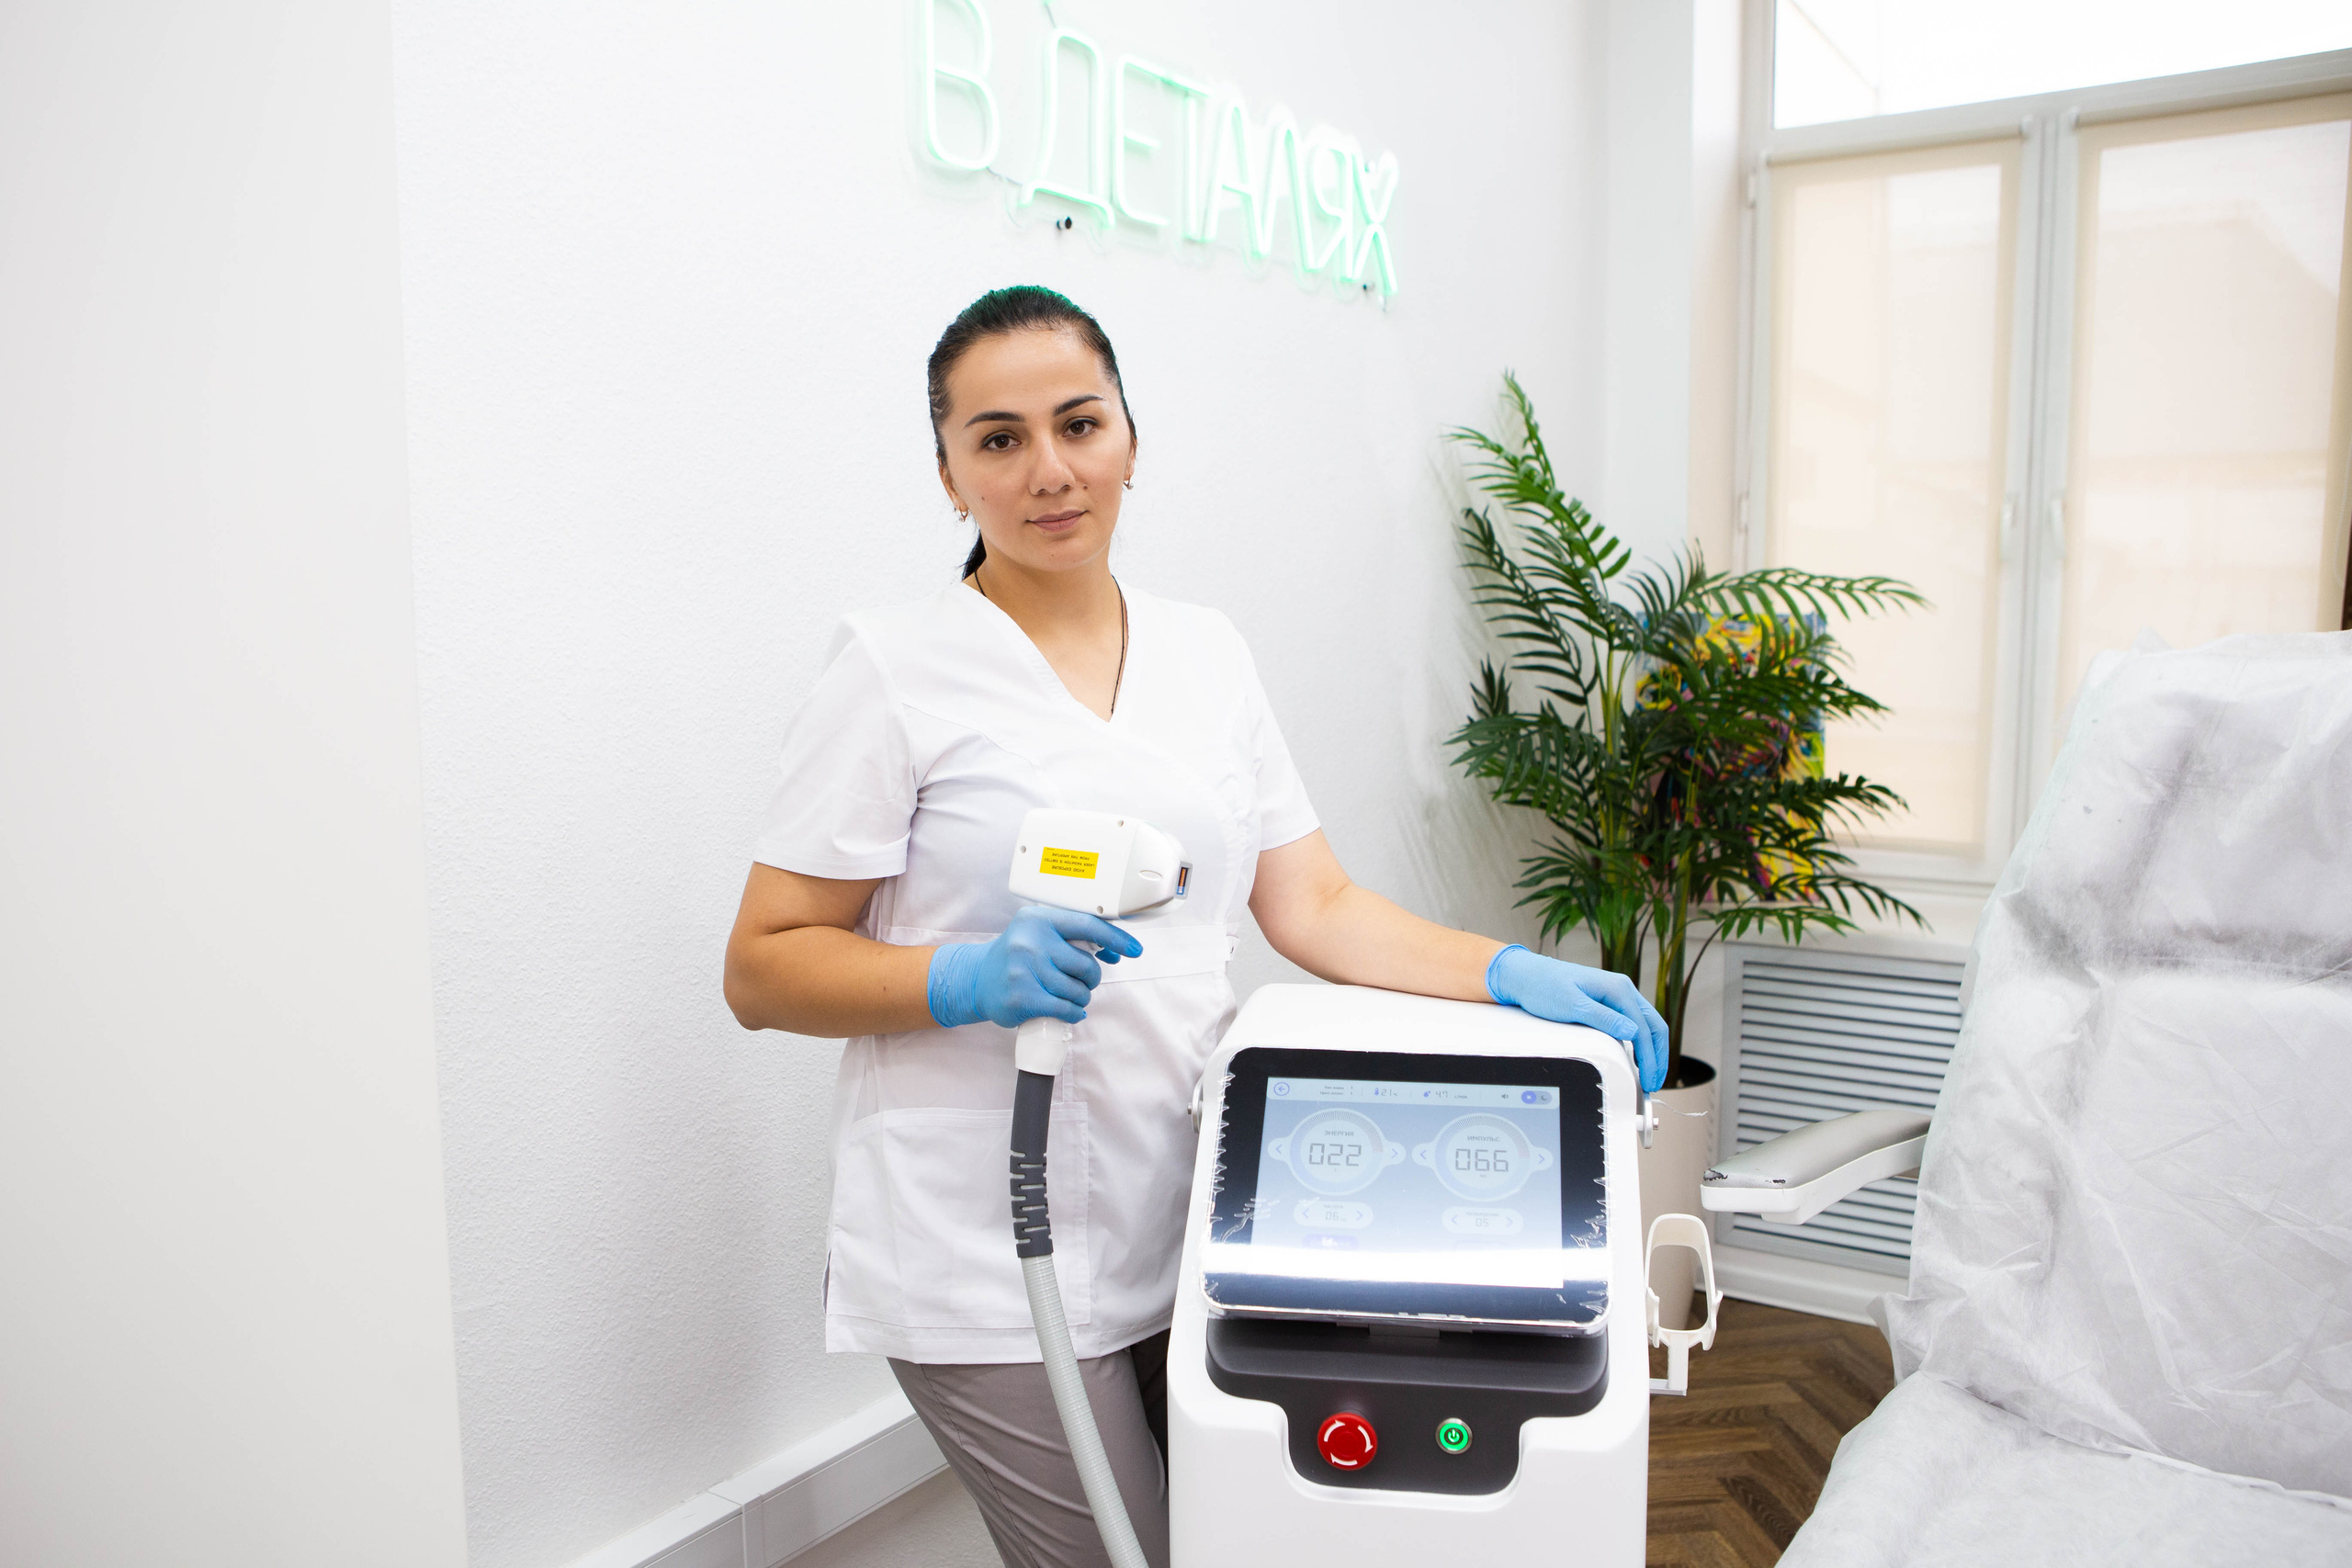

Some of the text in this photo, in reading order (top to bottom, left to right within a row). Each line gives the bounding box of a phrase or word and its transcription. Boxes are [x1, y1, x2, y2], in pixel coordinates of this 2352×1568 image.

[920, 0, 1398, 296] В ДЕТАЛЯХ
[1308, 1143, 1362, 1167] 022
[1455, 1148, 1510, 1173] 066
[1325, 1212, 1339, 1221] 06
[1476, 1218, 1489, 1227] 05
